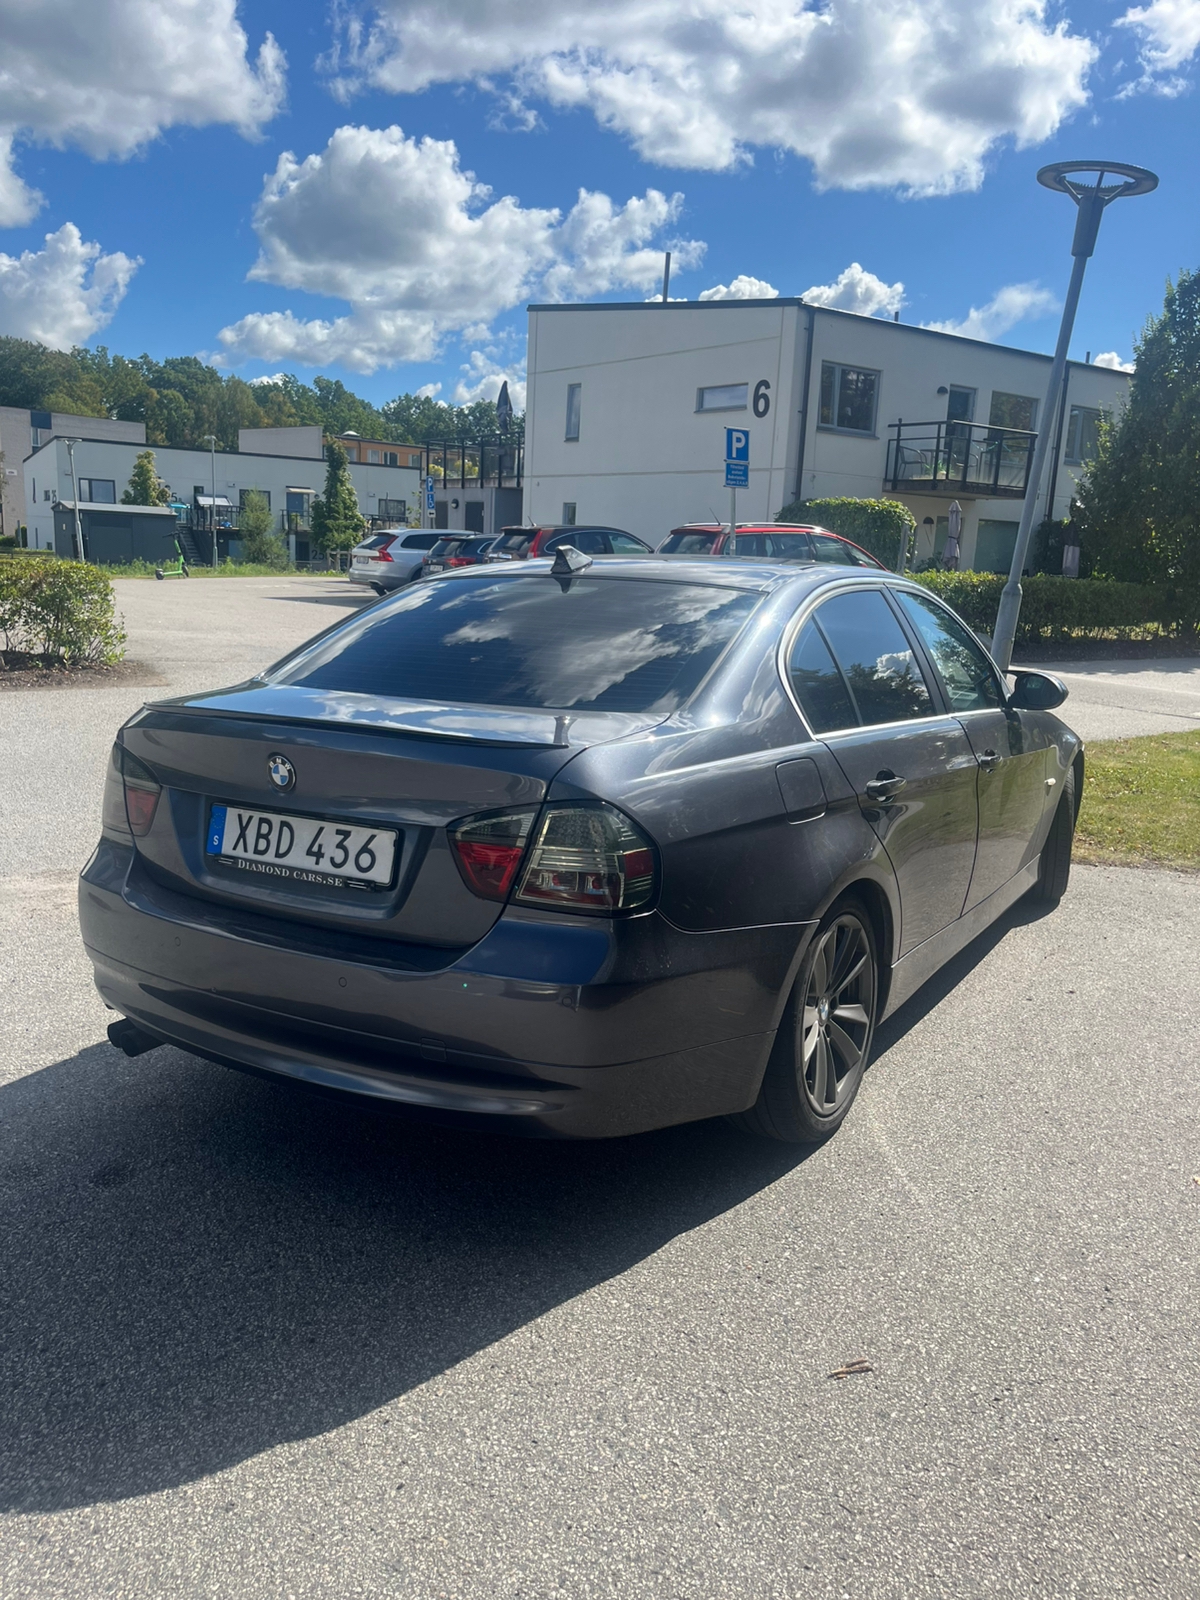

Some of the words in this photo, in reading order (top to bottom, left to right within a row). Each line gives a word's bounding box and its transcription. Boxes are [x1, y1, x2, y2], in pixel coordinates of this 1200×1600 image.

[753, 379, 770, 418] 6
[732, 431, 746, 458] P
[428, 478, 433, 490] P
[213, 835, 219, 846] S
[232, 813, 295, 859] XBD
[305, 826, 378, 873] 436
[237, 859, 290, 877] DIAMOND
[293, 870, 343, 888] CARS.SE
